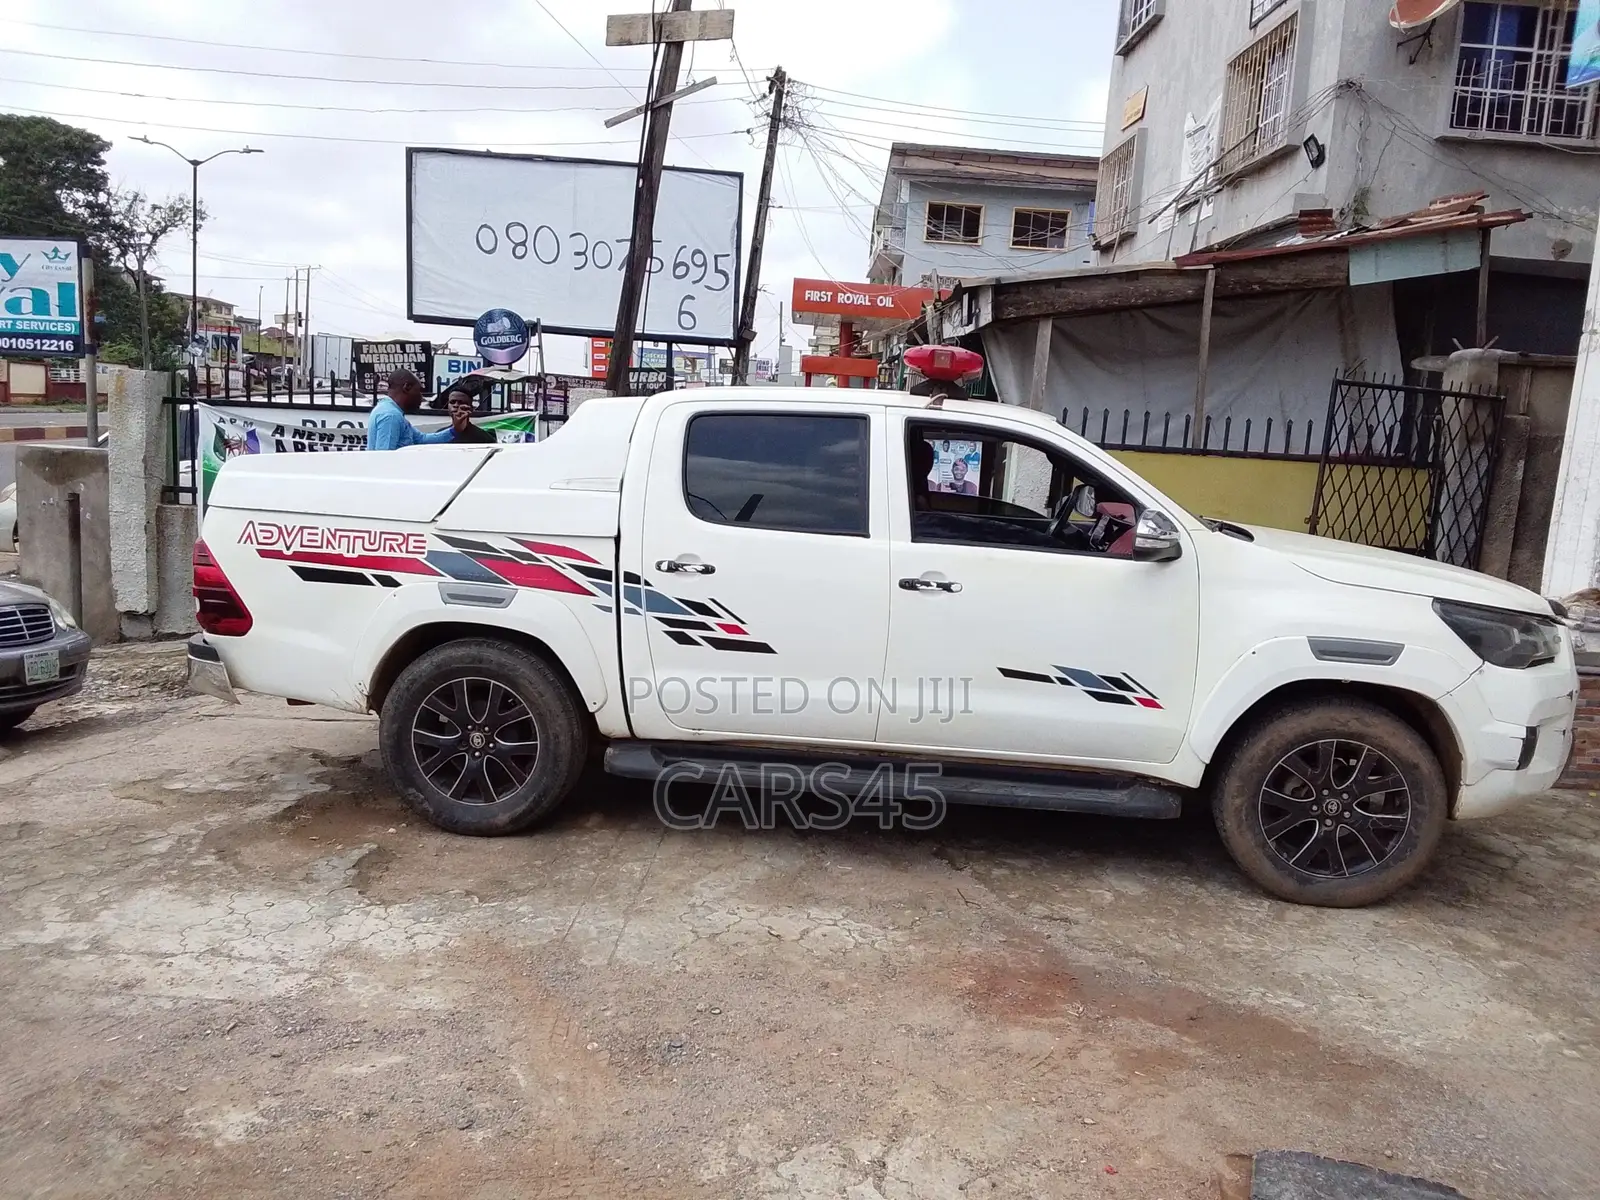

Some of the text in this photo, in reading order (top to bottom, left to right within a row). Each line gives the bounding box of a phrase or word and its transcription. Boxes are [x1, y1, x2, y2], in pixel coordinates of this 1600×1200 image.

[0, 281, 77, 317] al
[804, 289, 895, 308] FIRST ROYAL OIL
[677, 294, 697, 331] 6
[15, 321, 75, 334] SERVICES)
[480, 333, 522, 346] GOLDBERG
[362, 343, 423, 354] FAKOL DE
[360, 353, 426, 363] MERIDIAN
[374, 362, 418, 373] MOTEL
[271, 424, 285, 438] A
[291, 428, 336, 443] NEW
[236, 519, 428, 555] ADVENTURE
